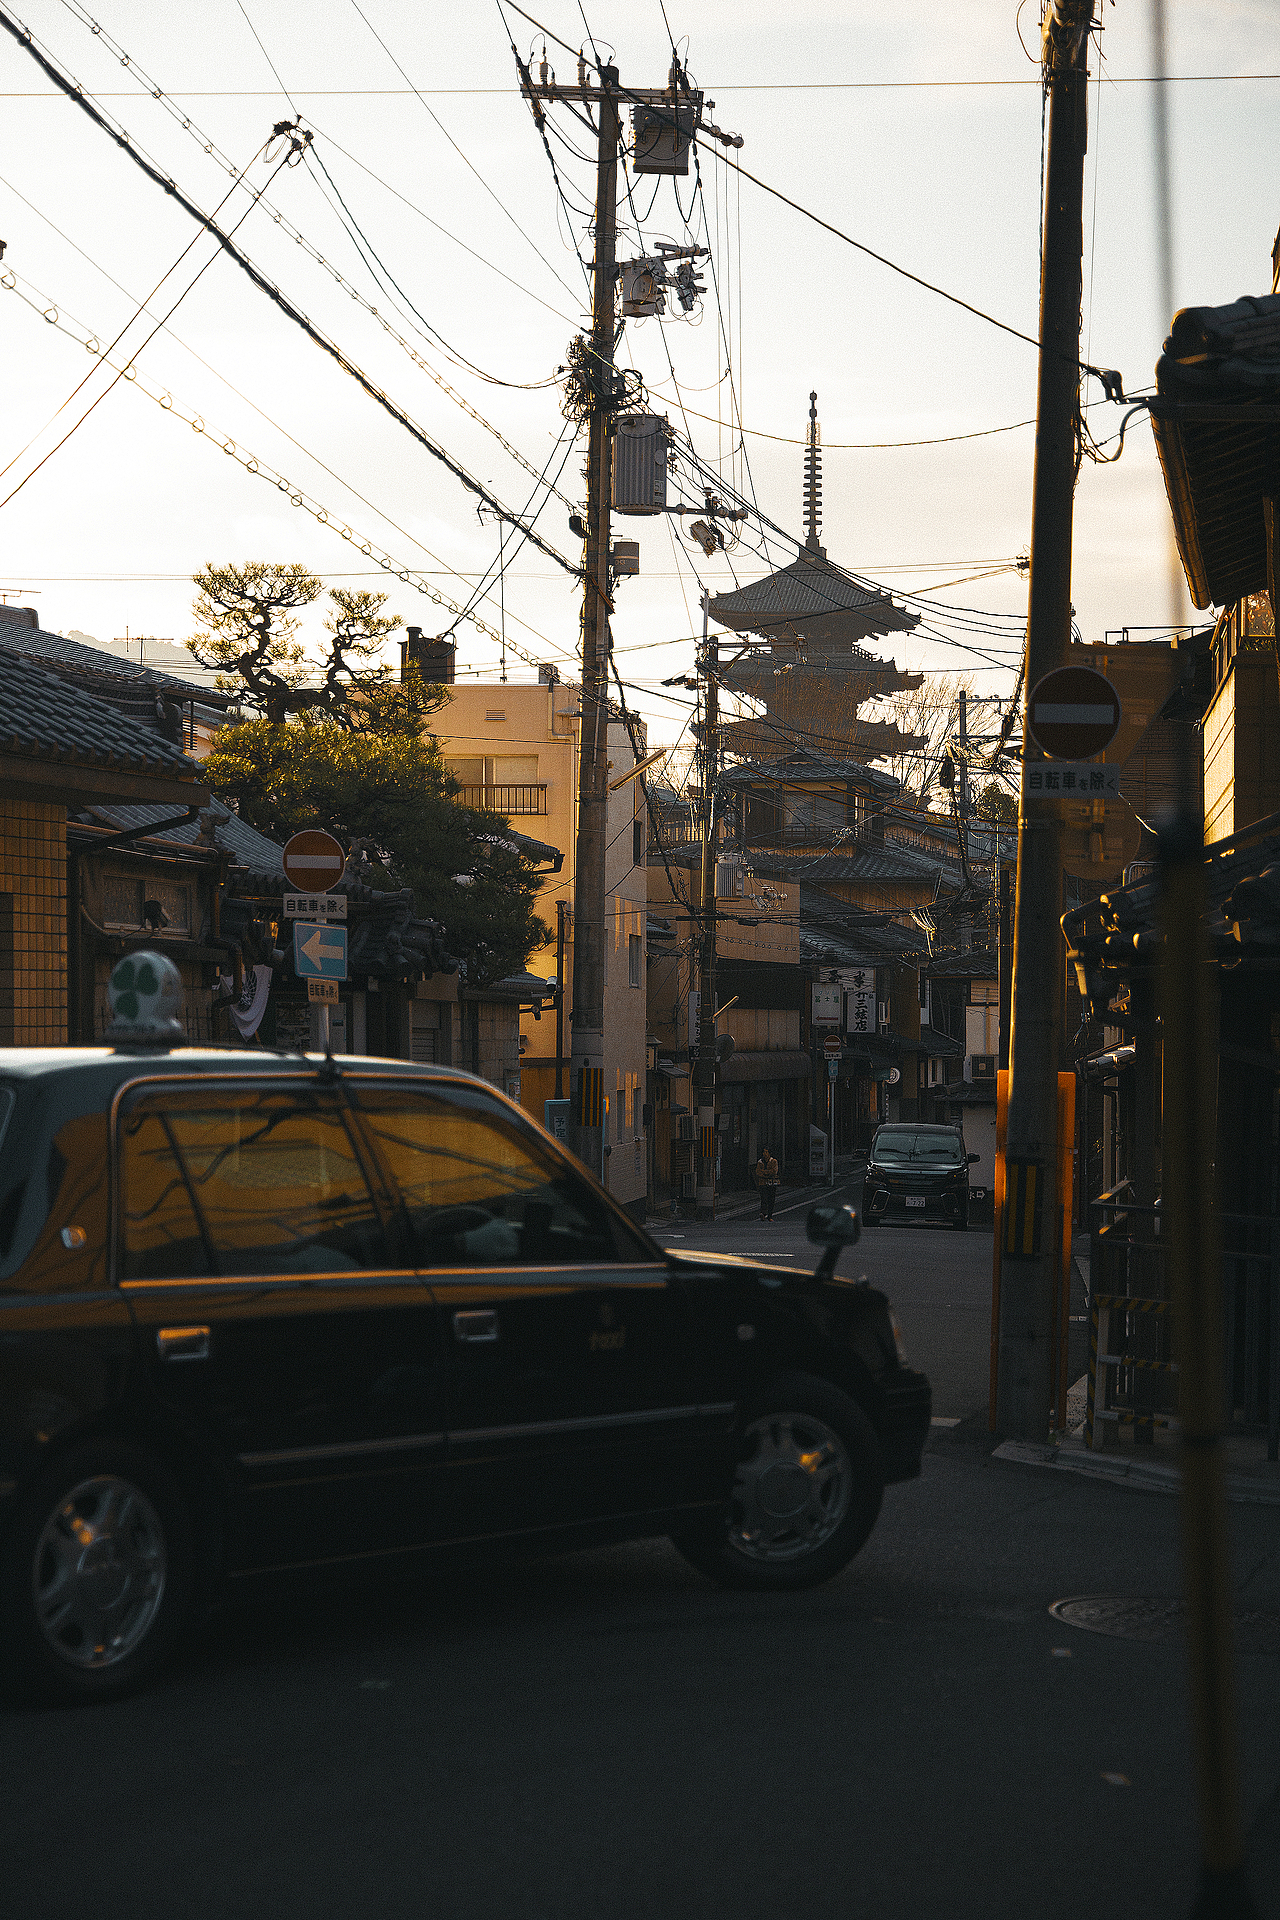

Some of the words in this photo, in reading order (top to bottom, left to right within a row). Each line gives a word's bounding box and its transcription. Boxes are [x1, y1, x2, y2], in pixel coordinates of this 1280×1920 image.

[1029, 771, 1116, 791] 自転車を除く
[286, 899, 345, 914] 自転車を除く
[309, 984, 338, 999] 自転車を除く
[555, 1117, 566, 1138] 予定
